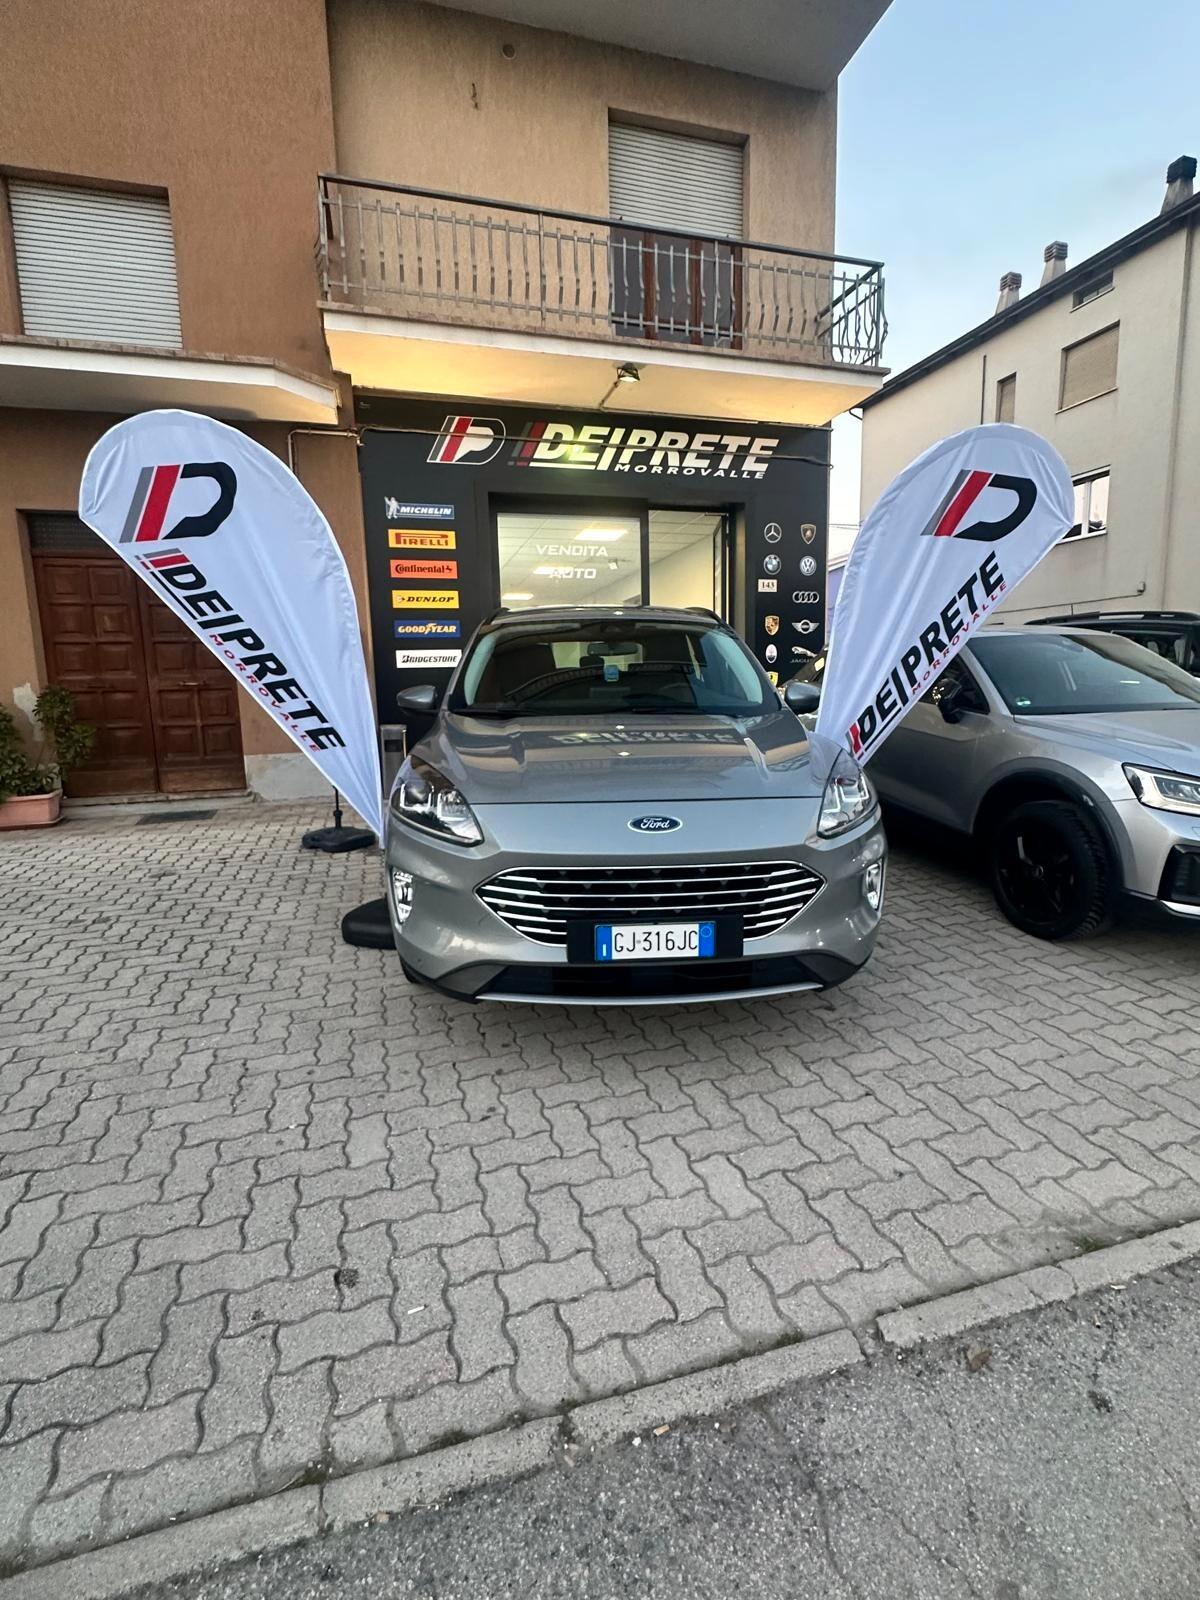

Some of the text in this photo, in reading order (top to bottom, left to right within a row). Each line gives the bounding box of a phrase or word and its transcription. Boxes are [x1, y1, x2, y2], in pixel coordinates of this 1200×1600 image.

[614, 463, 765, 480] MORROVALLE
[400, 506, 452, 515] MICHELIN
[395, 533, 449, 546] PIRELLI
[536, 545, 608, 557] VENDITA
[395, 563, 445, 574] Continental
[549, 568, 597, 579] AUTO
[398, 623, 457, 634] GOODYEAR
[911, 582, 1007, 695] MORROVALLE
[401, 655, 457, 663] BRIDGESTONE
[209, 634, 320, 752] MORROVALLE
[640, 817, 670, 829] Ford
